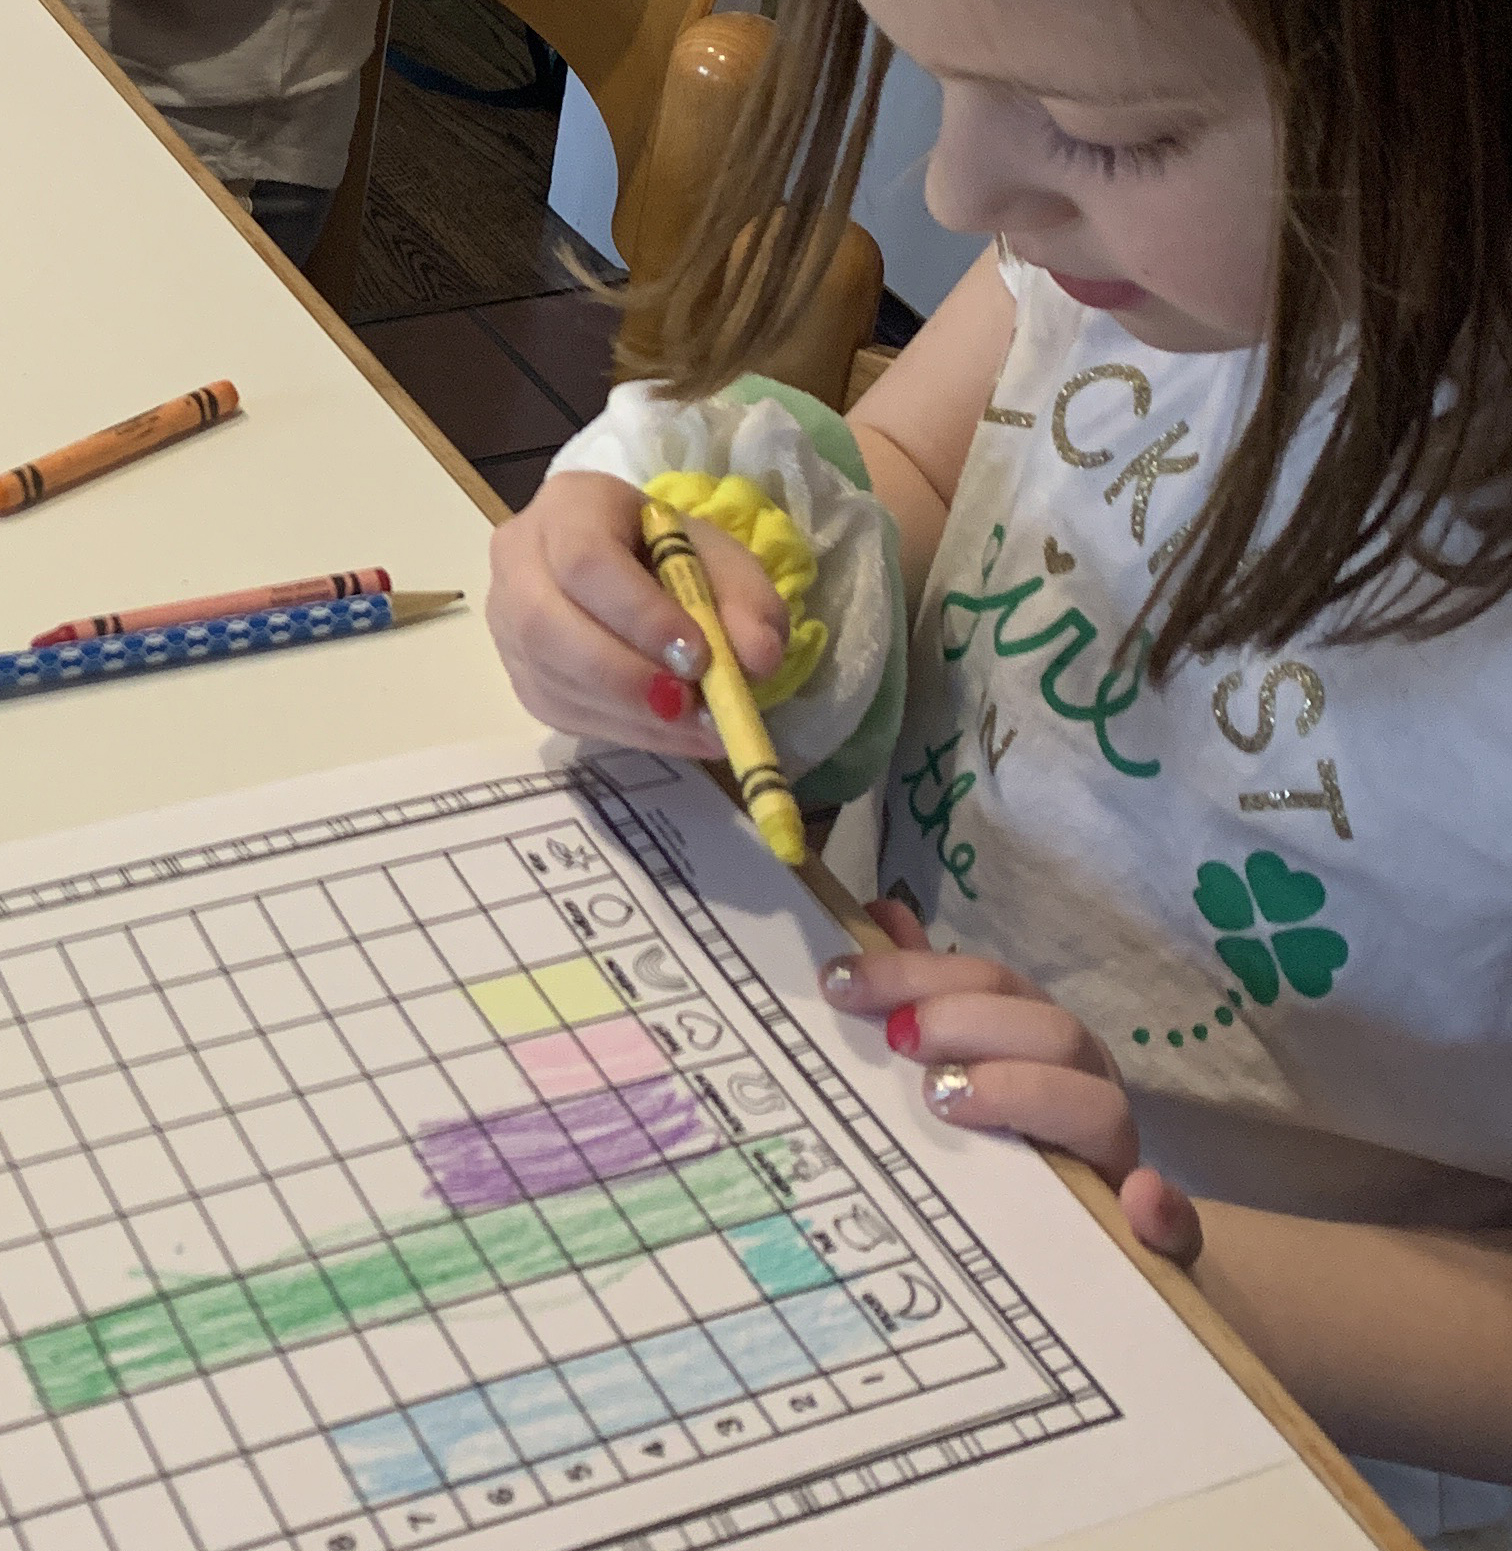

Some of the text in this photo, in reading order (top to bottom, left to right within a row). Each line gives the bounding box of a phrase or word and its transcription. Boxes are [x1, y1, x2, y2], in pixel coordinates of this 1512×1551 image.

[901, 730, 978, 900] the
[788, 1392, 817, 1414] 2
[714, 1415, 745, 1438] 3
[640, 1440, 666, 1458] 4
[564, 1461, 593, 1483] 5
[488, 1486, 515, 1507] 6
[407, 1512, 437, 1532] 7
